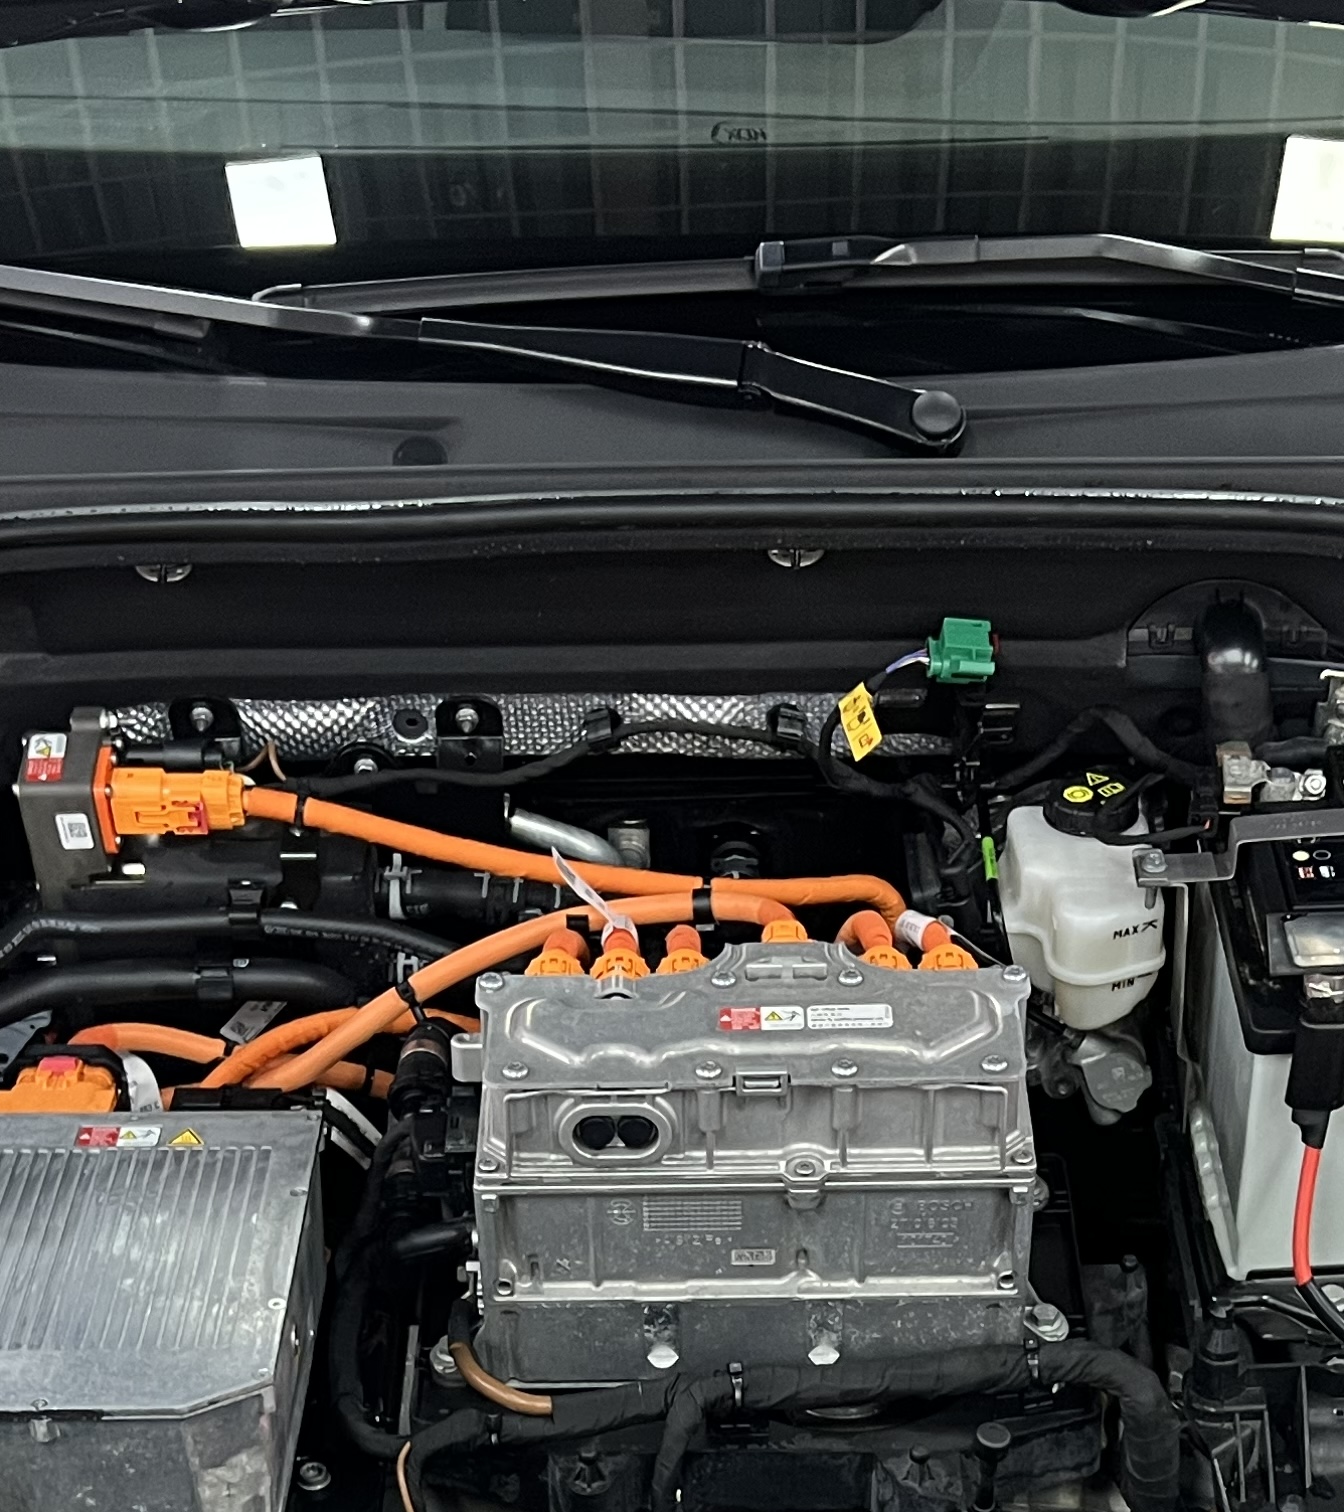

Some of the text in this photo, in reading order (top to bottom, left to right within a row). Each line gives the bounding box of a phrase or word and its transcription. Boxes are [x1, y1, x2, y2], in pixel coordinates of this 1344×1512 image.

[1113, 924, 1139, 939] MAX
[1111, 977, 1135, 991] MIN
[918, 1199, 973, 1212] BOSCH
